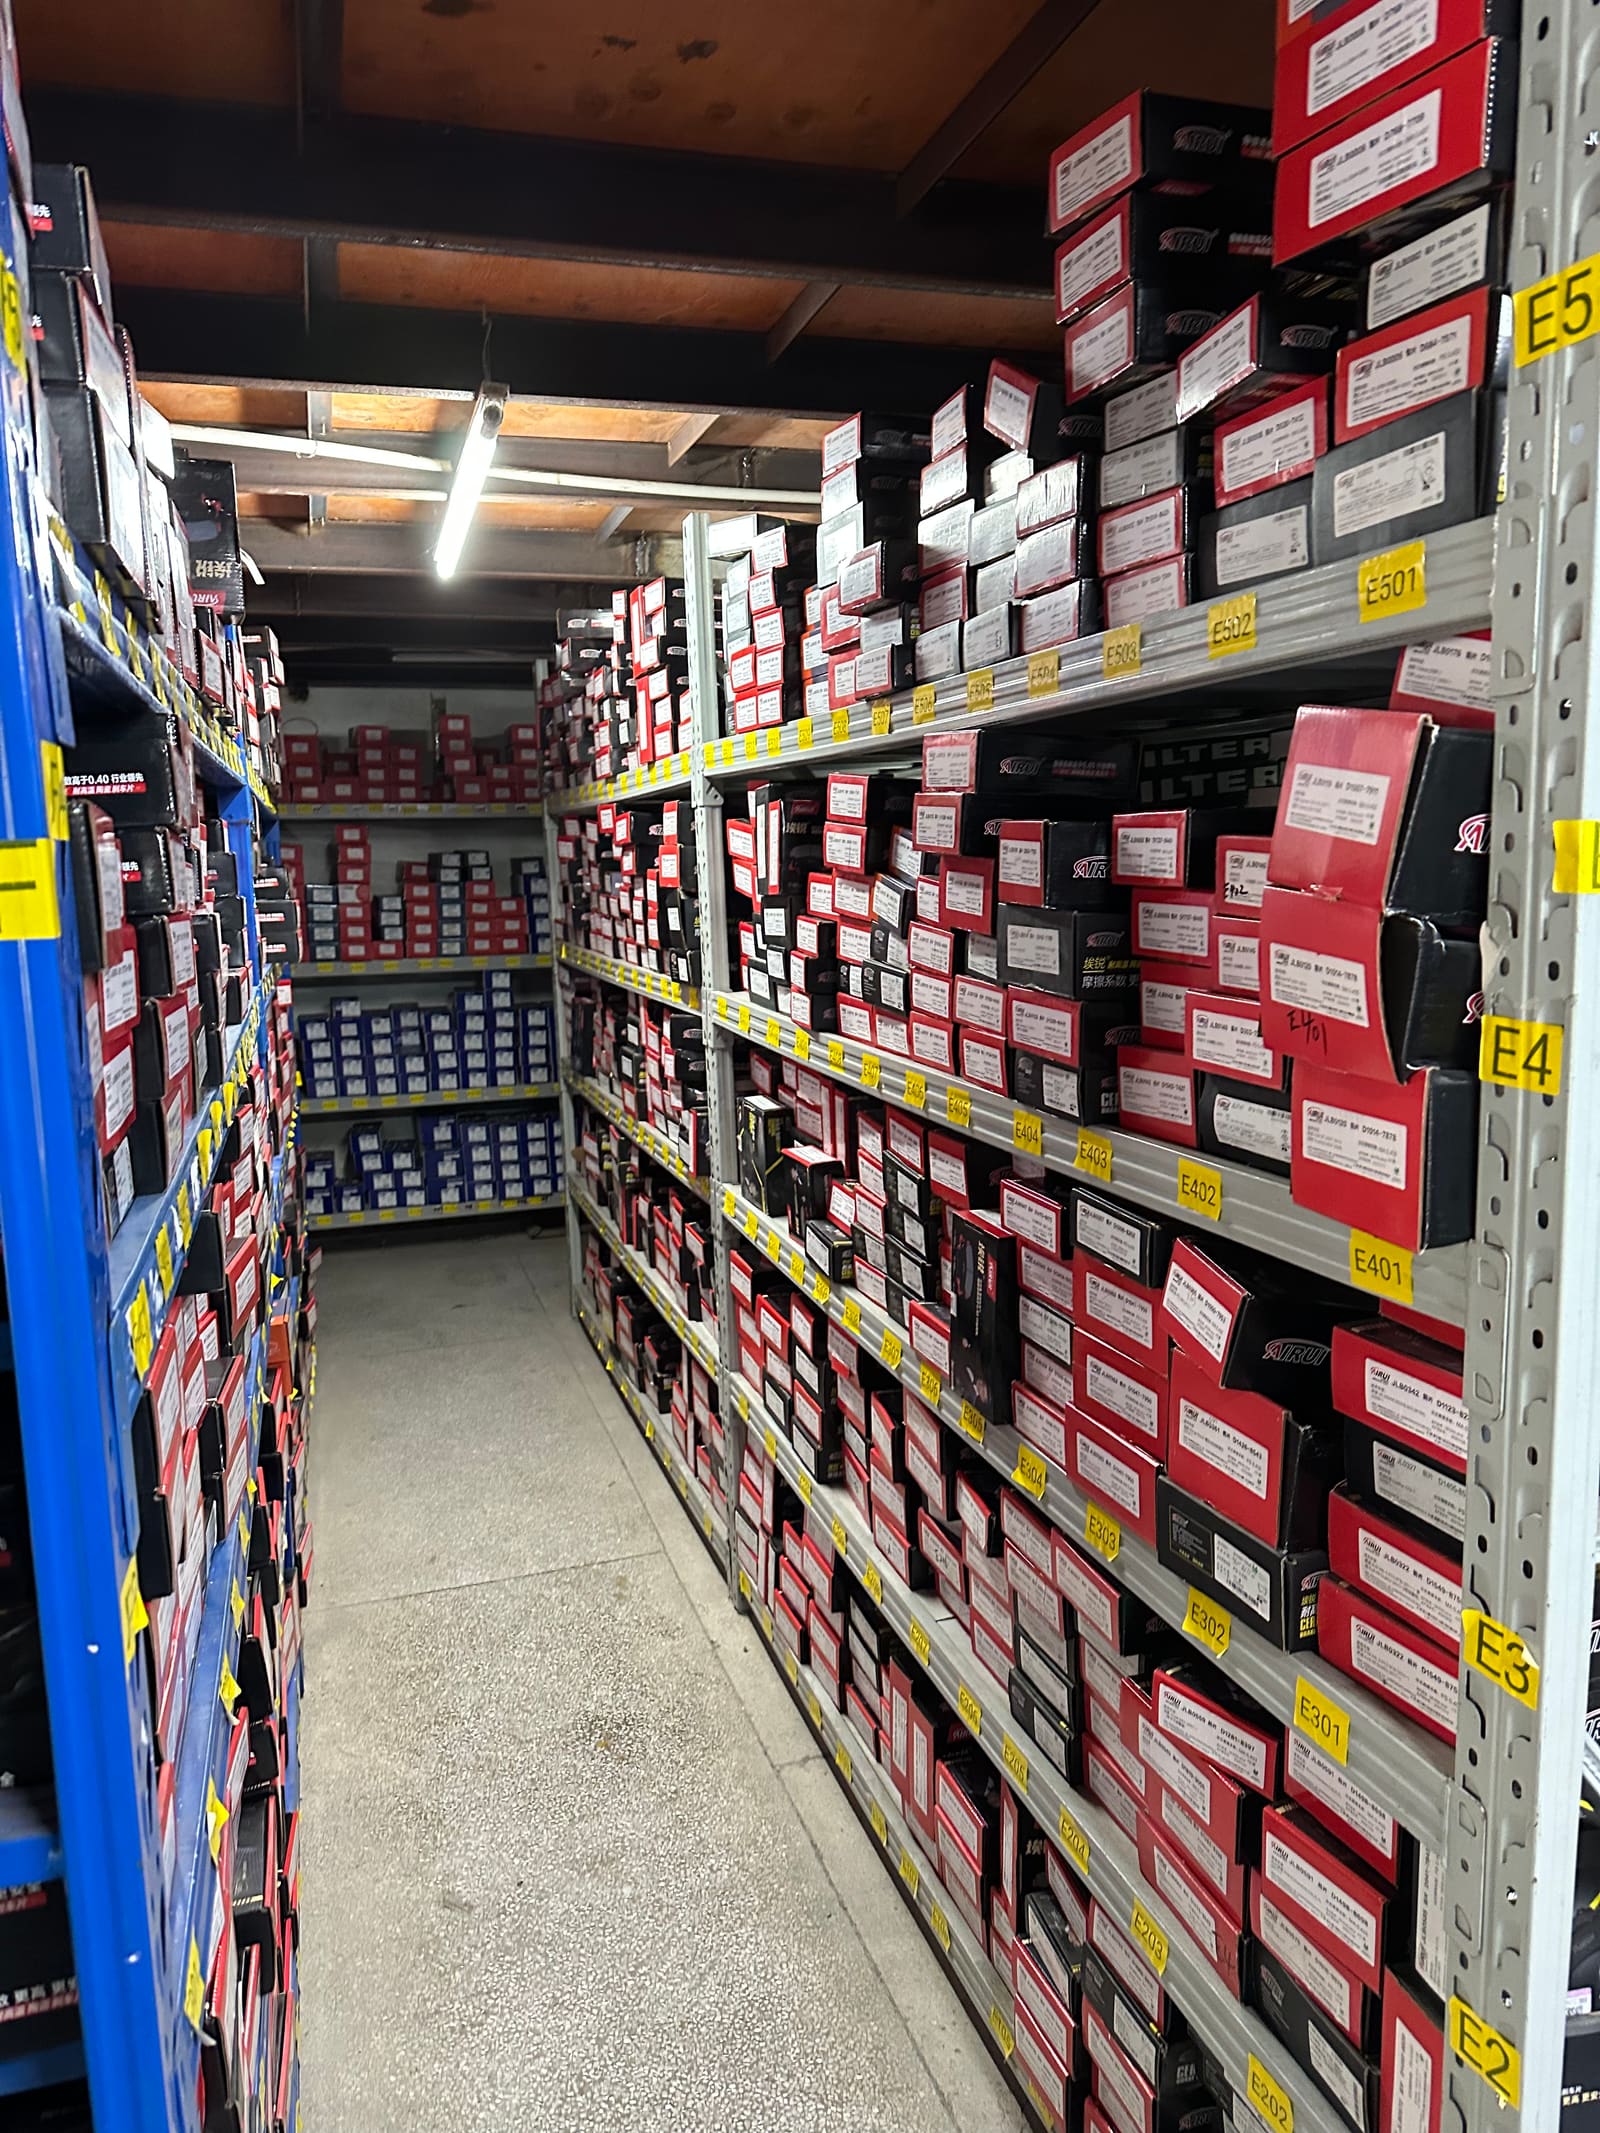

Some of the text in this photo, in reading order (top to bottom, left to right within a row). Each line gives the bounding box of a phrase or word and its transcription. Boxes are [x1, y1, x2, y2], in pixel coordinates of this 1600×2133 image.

[1527, 269, 1593, 353] E5
[1366, 567, 1416, 605] E501
[1212, 612, 1251, 644] E502
[1107, 641, 1137, 667] E503
[873, 710, 890, 727] E507
[863, 1062, 879, 1078] E407
[1492, 1025, 1550, 1083] E4
[949, 1097, 968, 1117] E405
[1015, 1123, 1039, 1144] E404
[1079, 1143, 1107, 1169] E403
[1182, 1174, 1216, 1207] E402
[1354, 1246, 1404, 1285] E401
[1263, 1338, 1331, 1365] AIRUI
[922, 1371, 938, 1395] E306
[963, 1404, 983, 1428] E305
[1020, 1456, 1043, 1489] E304
[1089, 1514, 1116, 1552] E303
[1191, 1603, 1228, 1646] E302
[1476, 1620, 1532, 1694] E3
[1299, 1700, 1342, 1748] E301
[1003, 1743, 1025, 1781] E205
[1061, 1820, 1087, 1858] E204
[1135, 1910, 1164, 1961] E203
[1458, 2009, 1512, 2098] E2
[1250, 2070, 1290, 2127] E202
